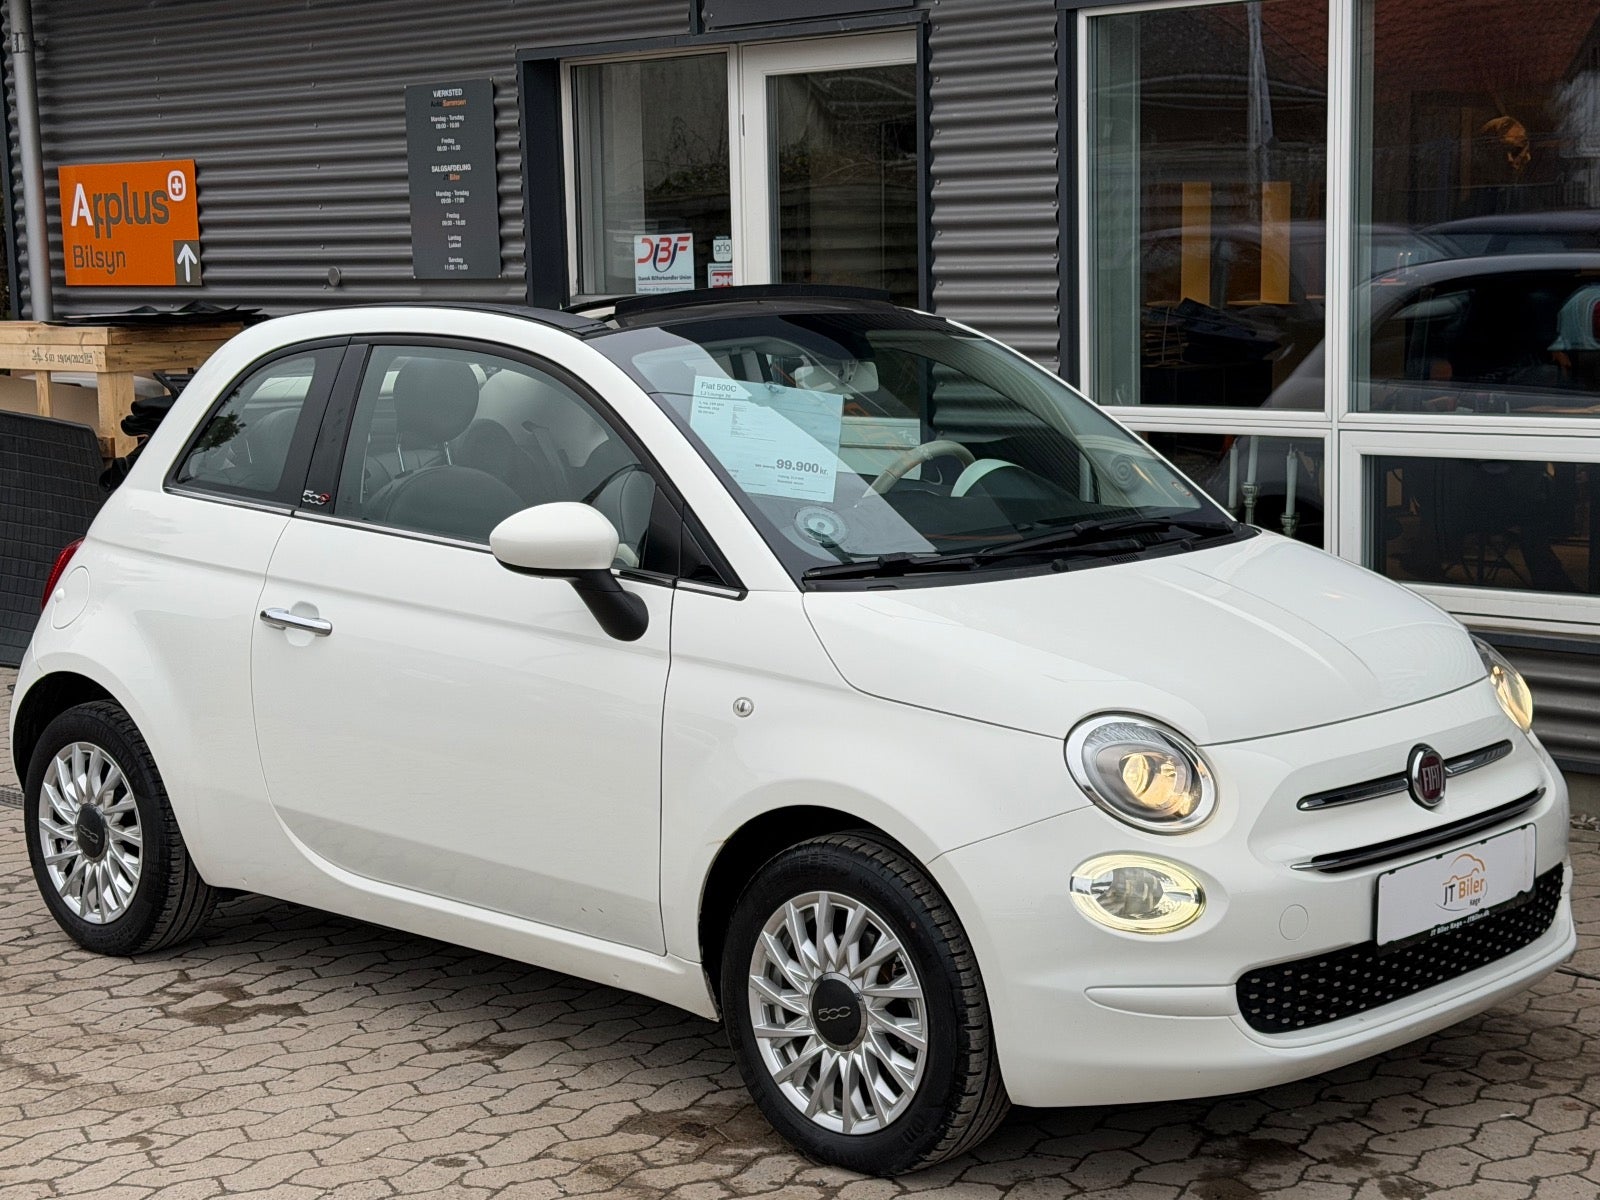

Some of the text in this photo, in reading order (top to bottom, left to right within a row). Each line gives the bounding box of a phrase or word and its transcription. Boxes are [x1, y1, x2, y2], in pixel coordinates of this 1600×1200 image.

[432, 88, 462, 98] VÆRKSTED
[431, 164, 472, 172] SALGSAFDELING
[73, 245, 126, 274] Bilsyn
[701, 382, 736, 392] Fiat 500C
[776, 459, 819, 473] 99.900
[1421, 764, 1440, 792] FIAT
[1443, 877, 1485, 906] JT Biler
[1437, 926, 1449, 934] Biler
[818, 1006, 852, 1021] 500
